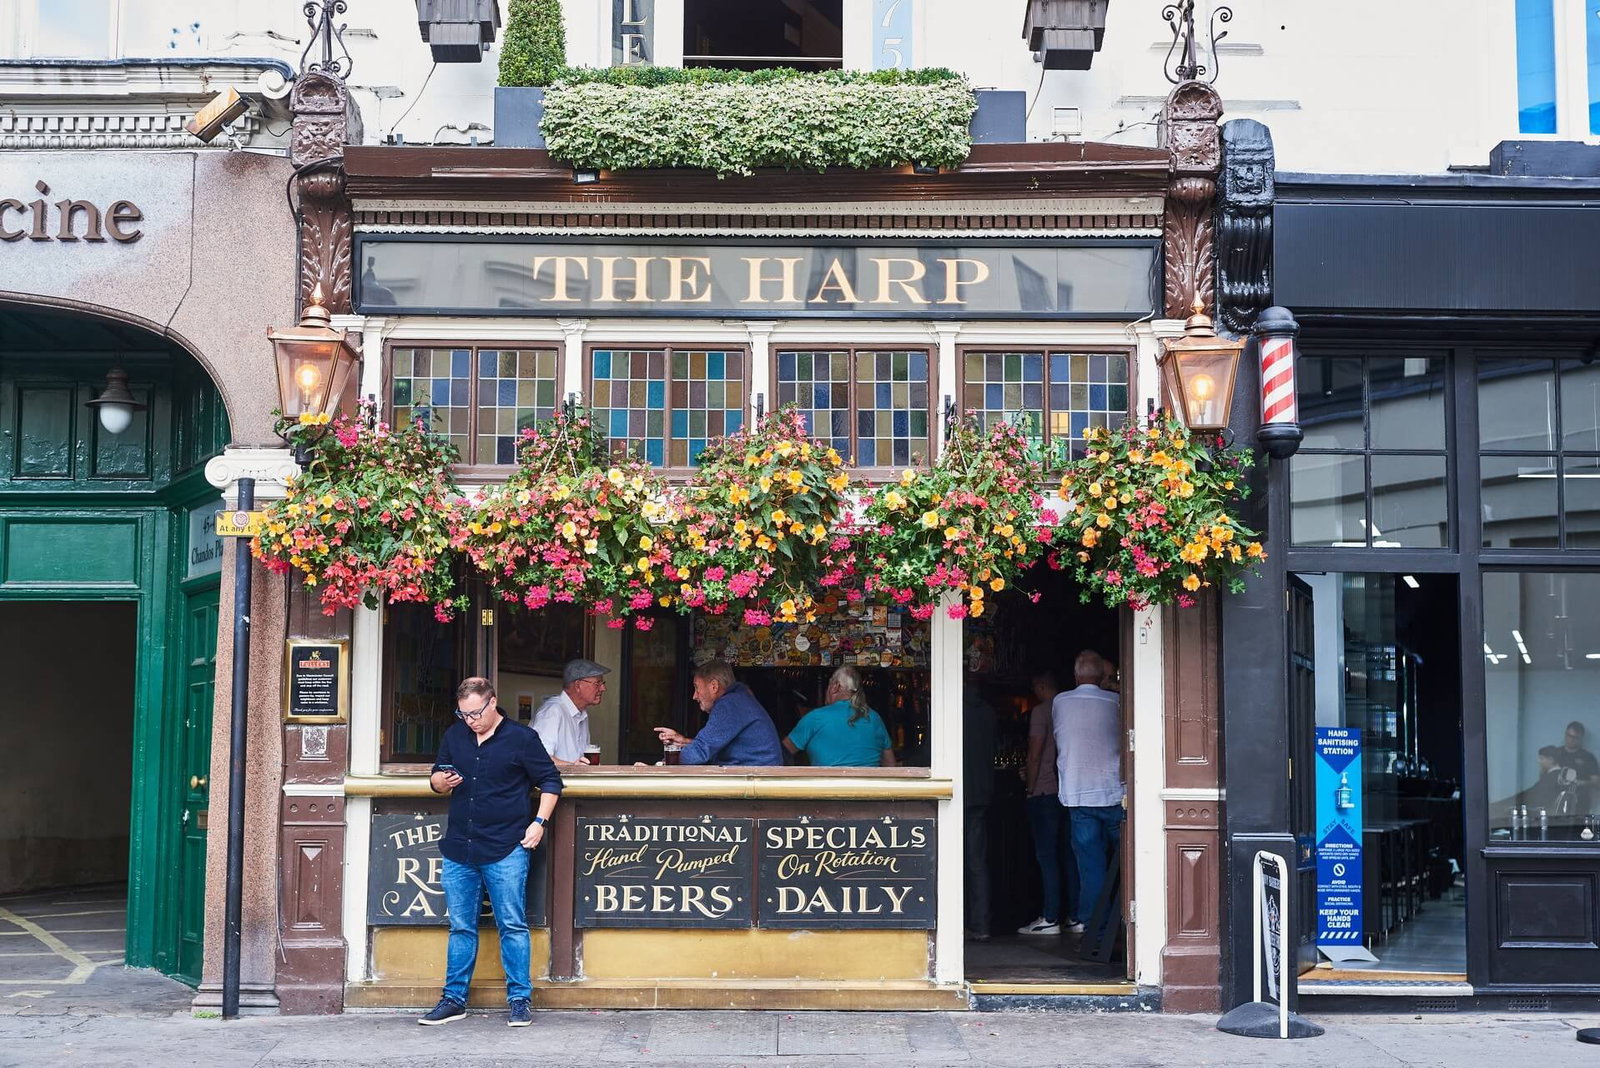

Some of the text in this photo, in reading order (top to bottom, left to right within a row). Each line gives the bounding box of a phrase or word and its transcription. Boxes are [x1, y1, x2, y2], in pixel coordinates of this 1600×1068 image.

[0, 179, 144, 242] cine
[533, 256, 990, 304] THE HARP
[1318, 738, 1359, 746] SANITISING
[1328, 729, 1348, 737] HAND
[1323, 747, 1354, 755] STATION
[389, 823, 443, 850] THE
[585, 824, 748, 843] TRADITIONAL
[766, 826, 927, 849] SPECIALS
[582, 844, 740, 880] Hand Pumped
[777, 849, 901, 880] On Rotation
[593, 885, 734, 918] BEERS
[775, 886, 913, 913] DAILY
